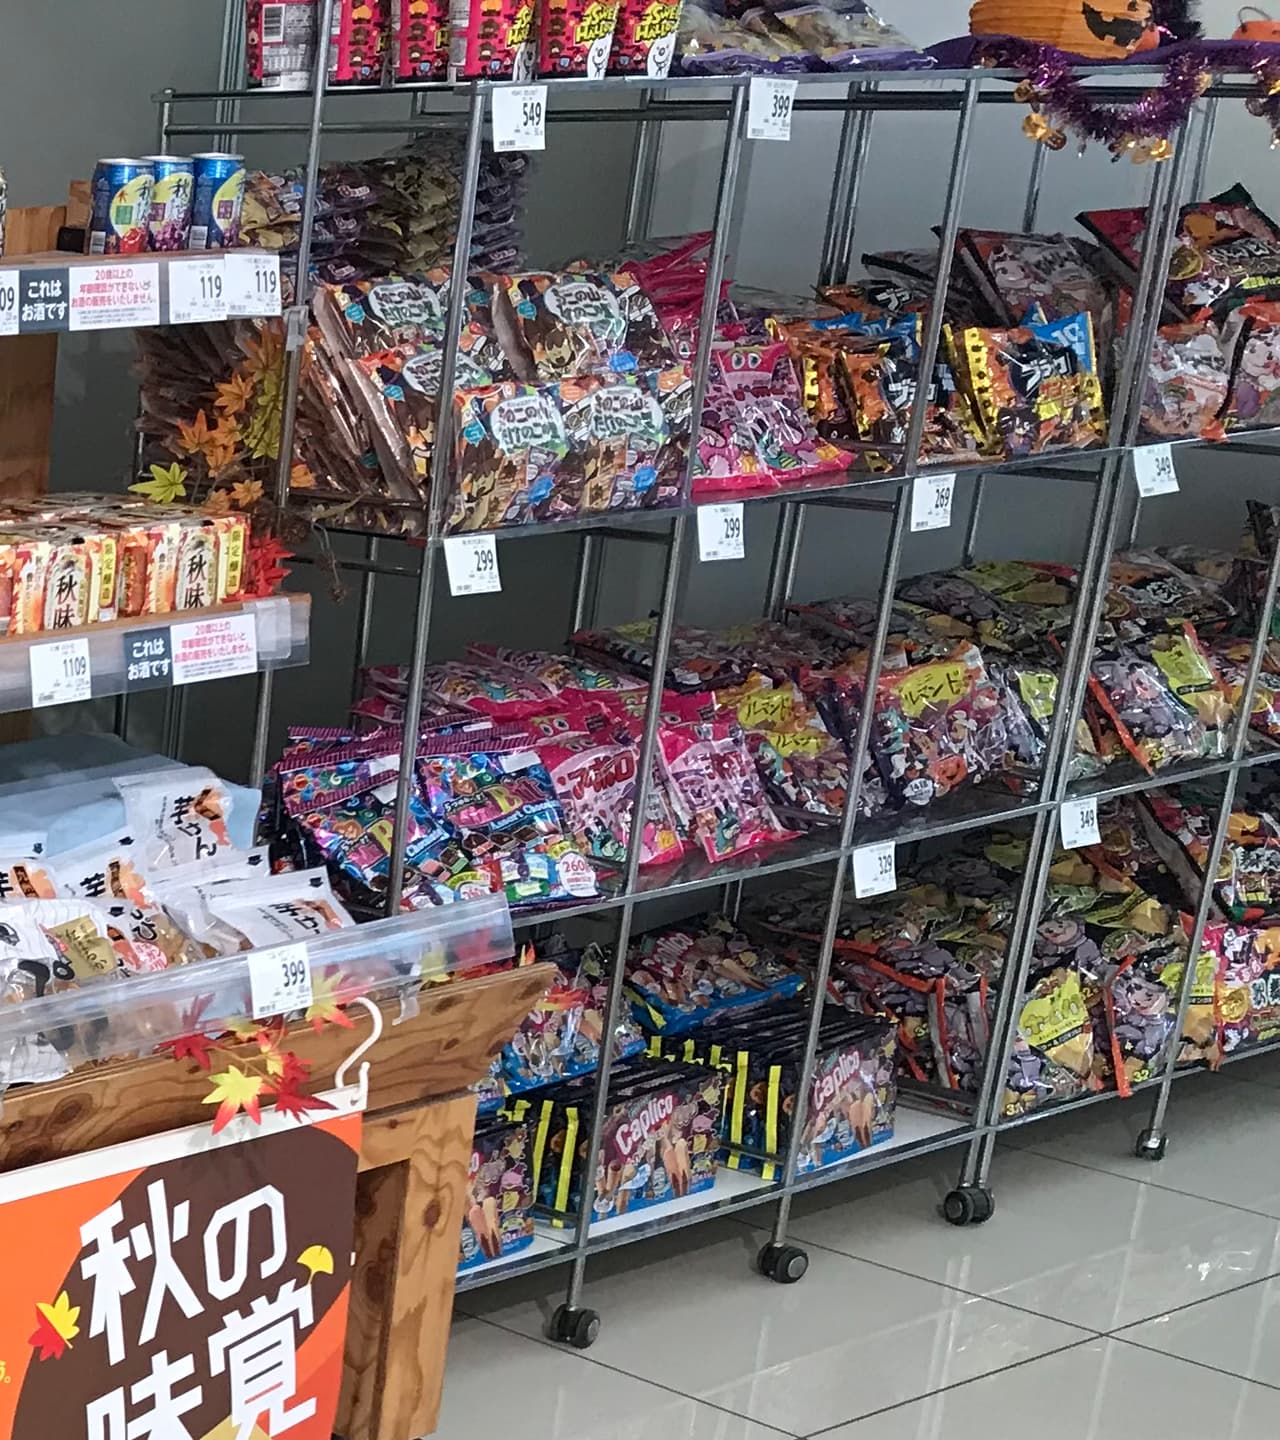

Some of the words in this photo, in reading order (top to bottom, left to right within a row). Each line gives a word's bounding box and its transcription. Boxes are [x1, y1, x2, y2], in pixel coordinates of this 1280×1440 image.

[522, 102, 541, 127] 549
[771, 95, 790, 118] 399
[28, 279, 61, 298] これは
[200, 275, 222, 298] 119
[255, 270, 278, 294] 119
[22, 301, 68, 322] お酒です
[1155, 456, 1173, 477] 349
[724, 518, 741, 540] 299
[475, 549, 494, 572] 299
[132, 638, 165, 657] これは
[63, 656, 87, 678] 1109
[127, 658, 170, 681] お酒です
[904, 669, 961, 706] ルマンド
[1080, 810, 1096, 830] 349
[879, 854, 893, 875] 329
[281, 961, 306, 987] 399
[813, 1050, 860, 1110] Caplico
[616, 1095, 673, 1156] Caplico
[78, 1178, 288, 1366] 秋の
